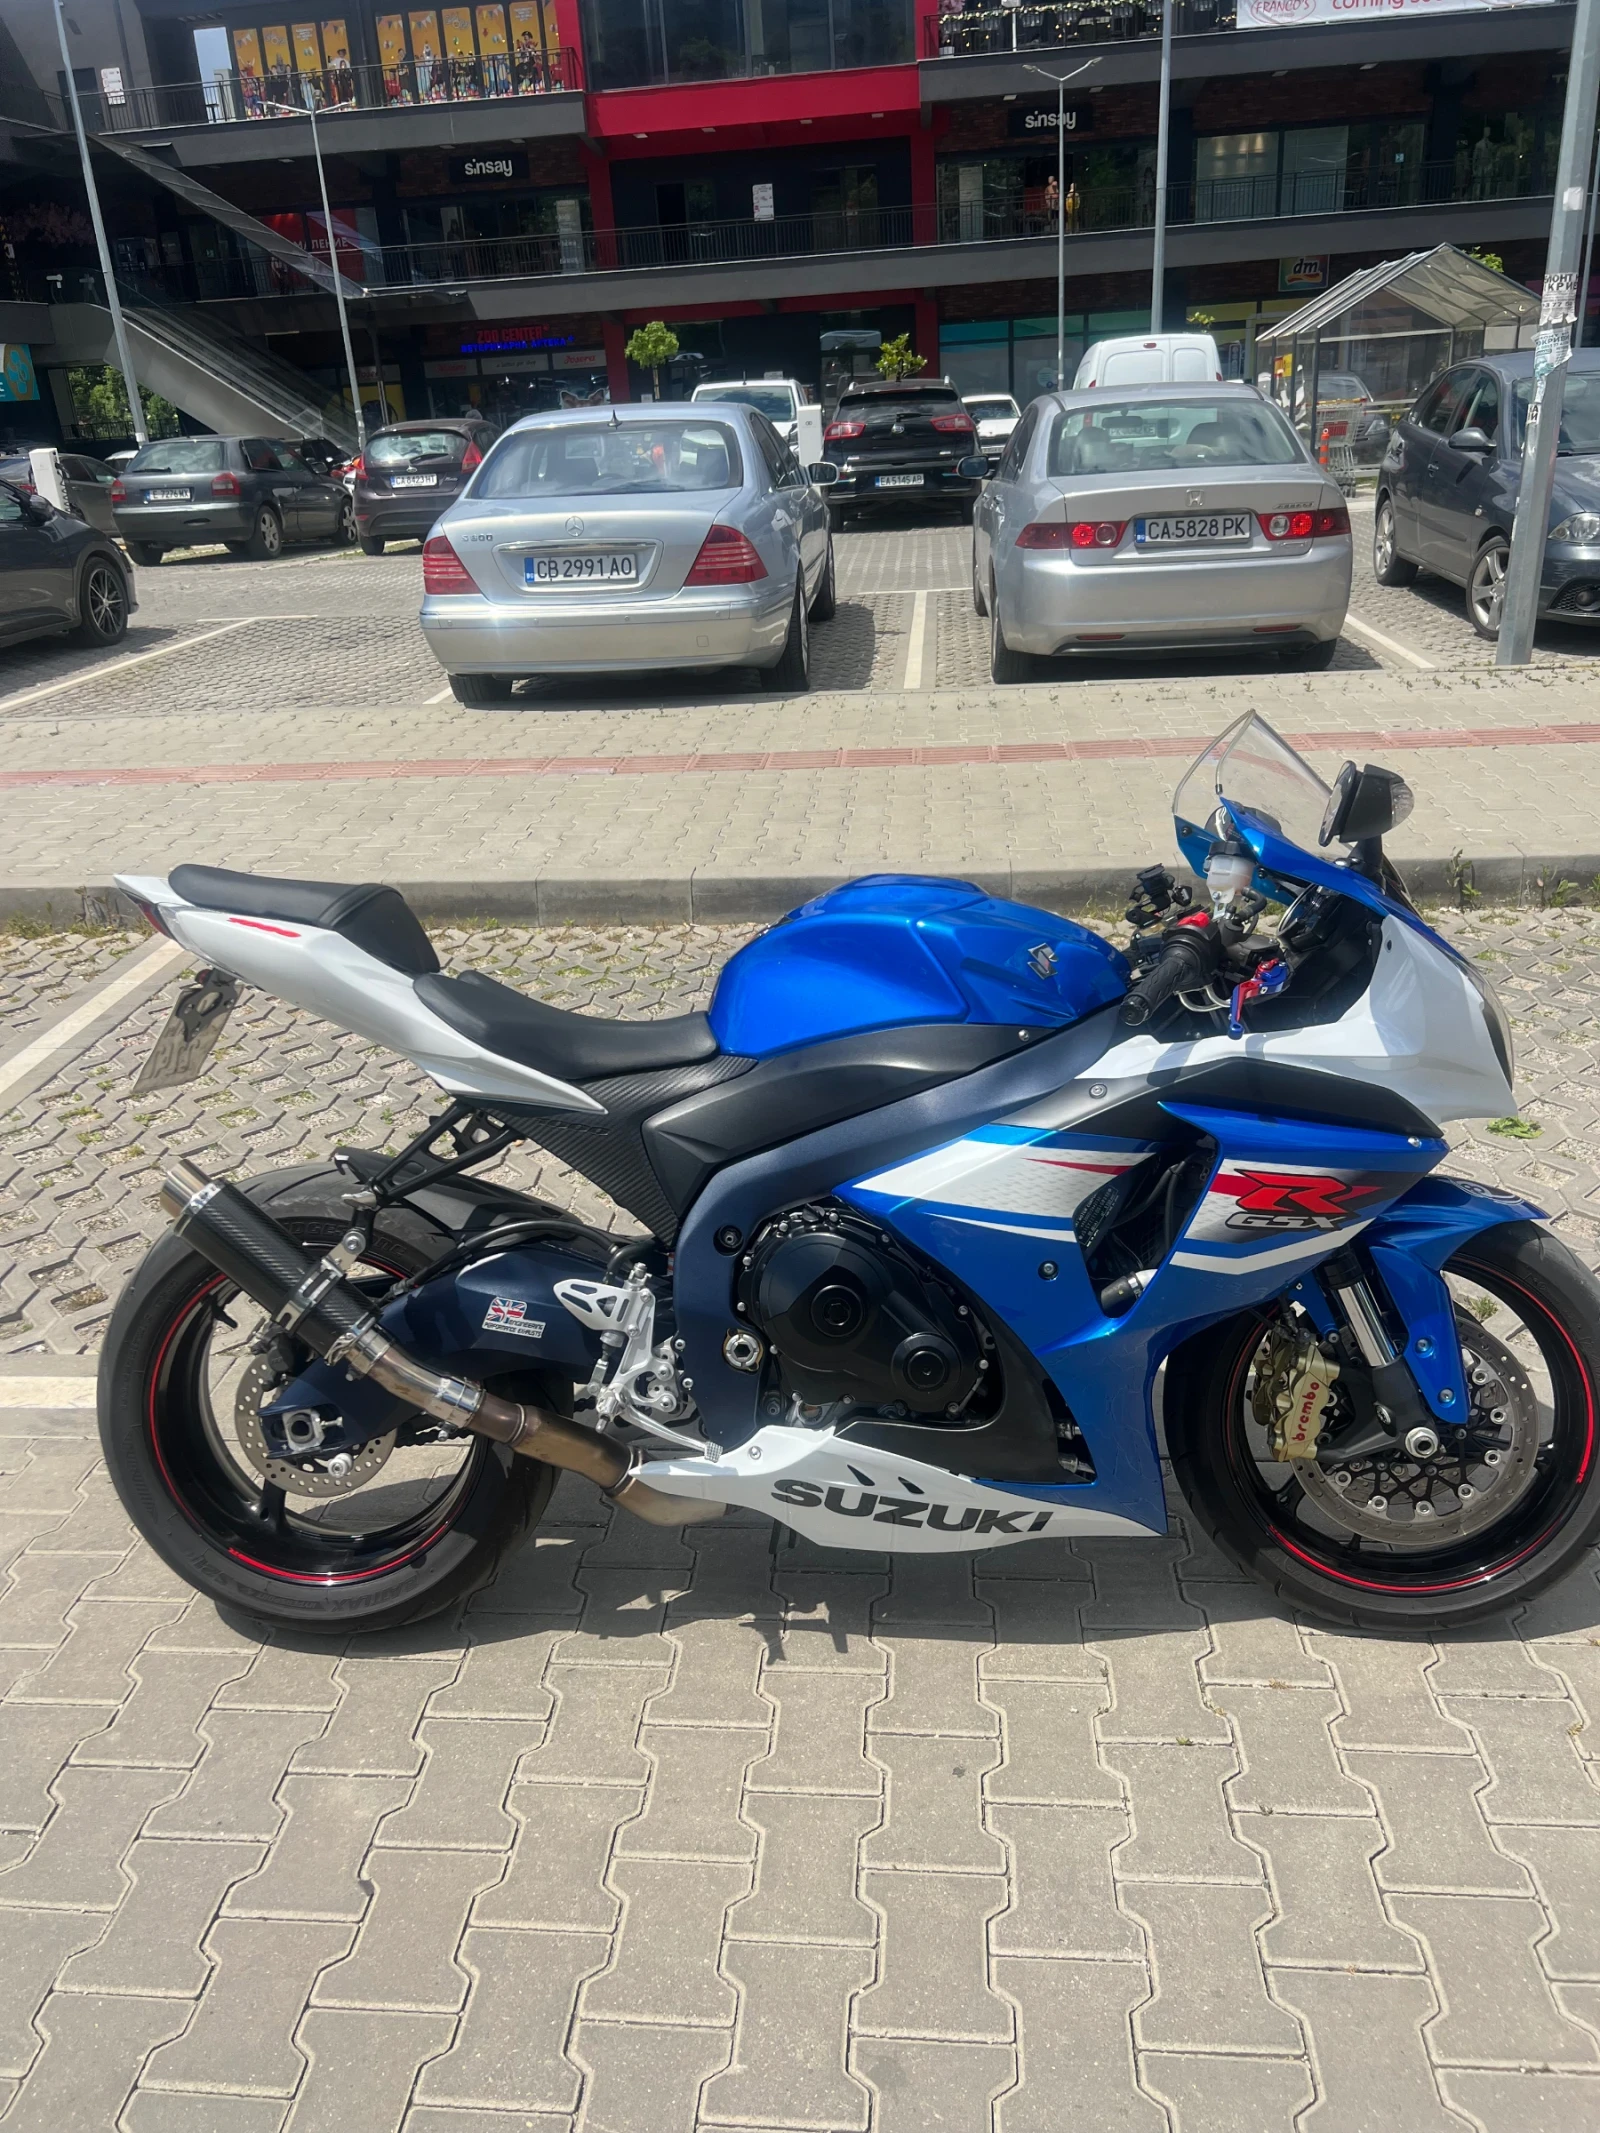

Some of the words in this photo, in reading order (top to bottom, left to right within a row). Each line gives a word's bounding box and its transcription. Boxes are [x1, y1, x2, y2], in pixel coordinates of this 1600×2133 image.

[1024, 110, 1077, 130] sinsay
[464, 158, 513, 177] sinsay
[1293, 257, 1319, 275] dm
[501, 326, 543, 342] CENTER
[1148, 521, 1171, 540] CA
[1175, 518, 1219, 538] 5828
[1223, 516, 1246, 536] PK
[537, 560, 559, 579] CB
[563, 558, 604, 578] 2991
[610, 556, 633, 576] AO
[1226, 1213, 1347, 1230] GSX
[1291, 1382, 1320, 1442] brembo
[770, 1478, 1054, 1534] SUZUKI
